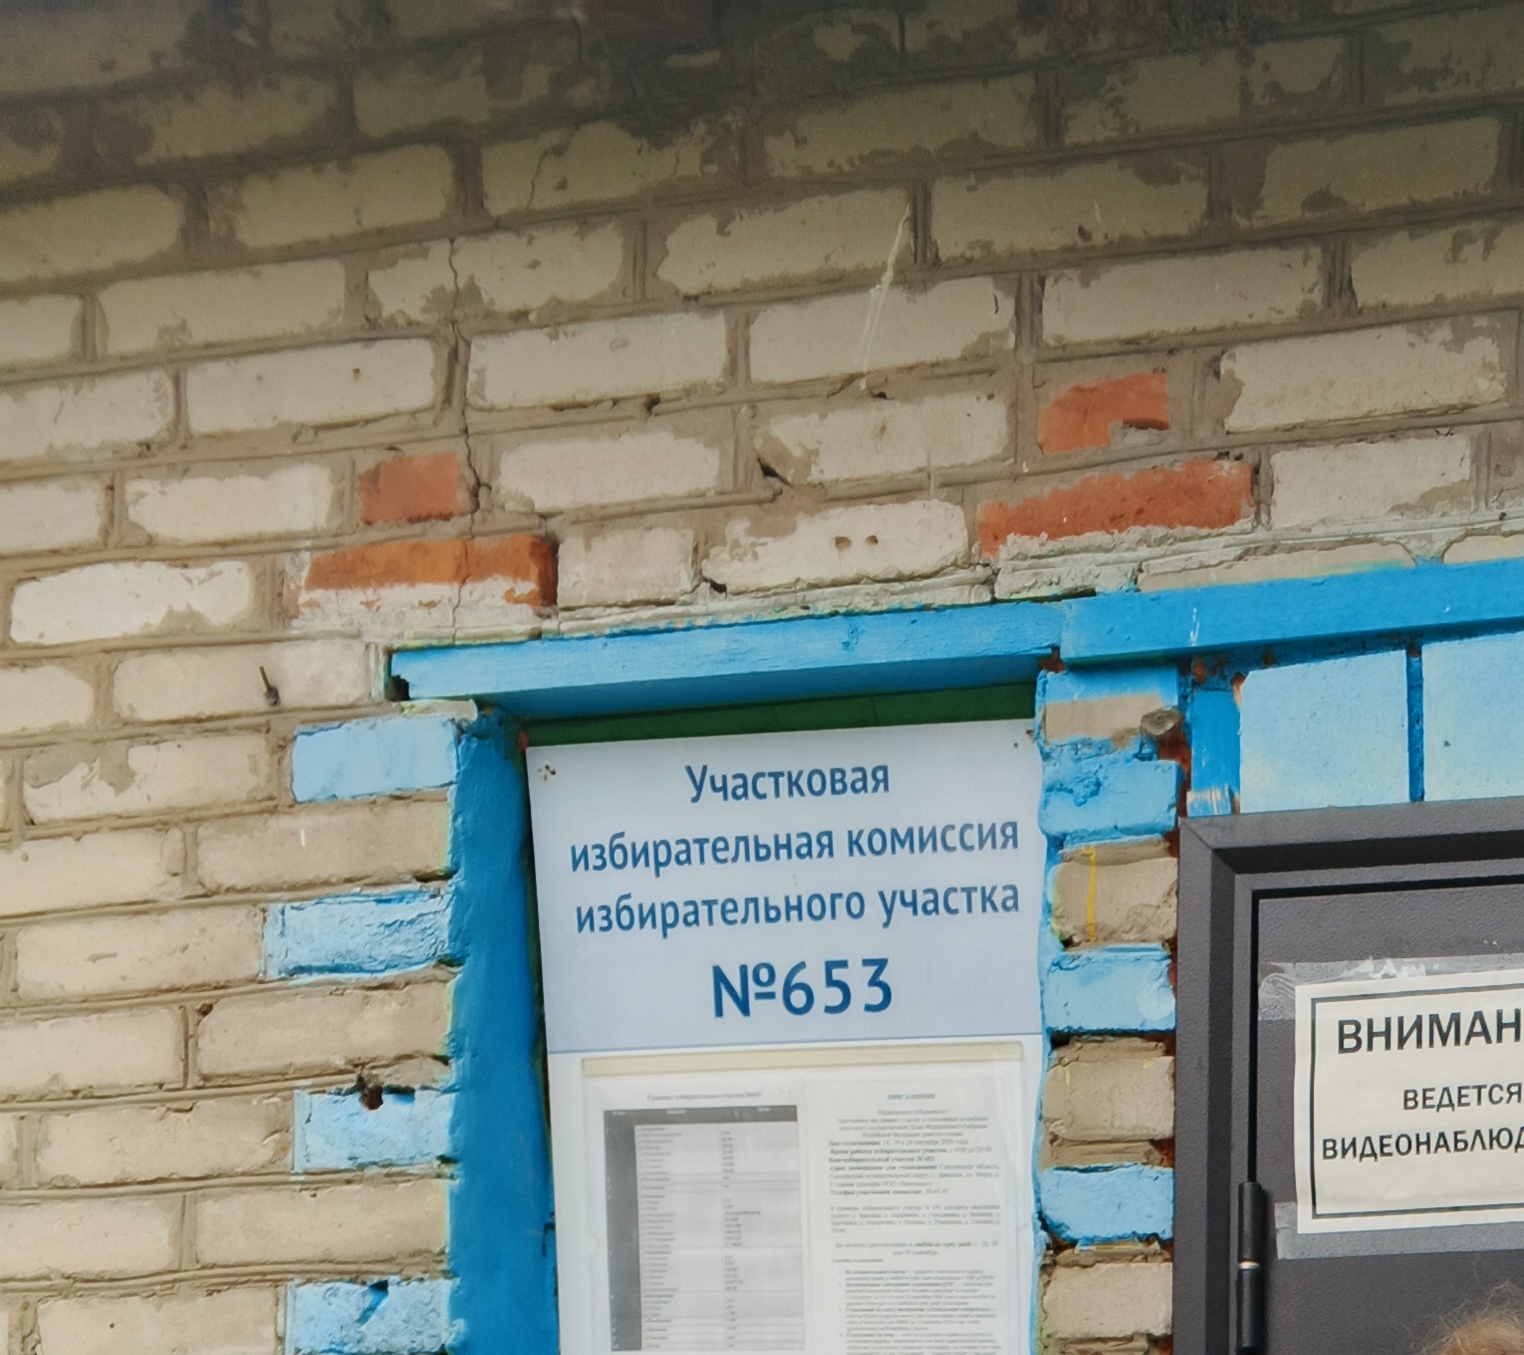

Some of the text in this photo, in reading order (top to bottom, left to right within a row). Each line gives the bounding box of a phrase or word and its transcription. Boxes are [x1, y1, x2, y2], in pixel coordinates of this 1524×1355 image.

[685, 764, 890, 803] Участковая
[570, 820, 1019, 878] избирательная комиссия
[575, 882, 1020, 939] избирательного участка
[712, 957, 893, 1018] №653
[1403, 1081, 1523, 1113] ВЕДЕТСЯ
